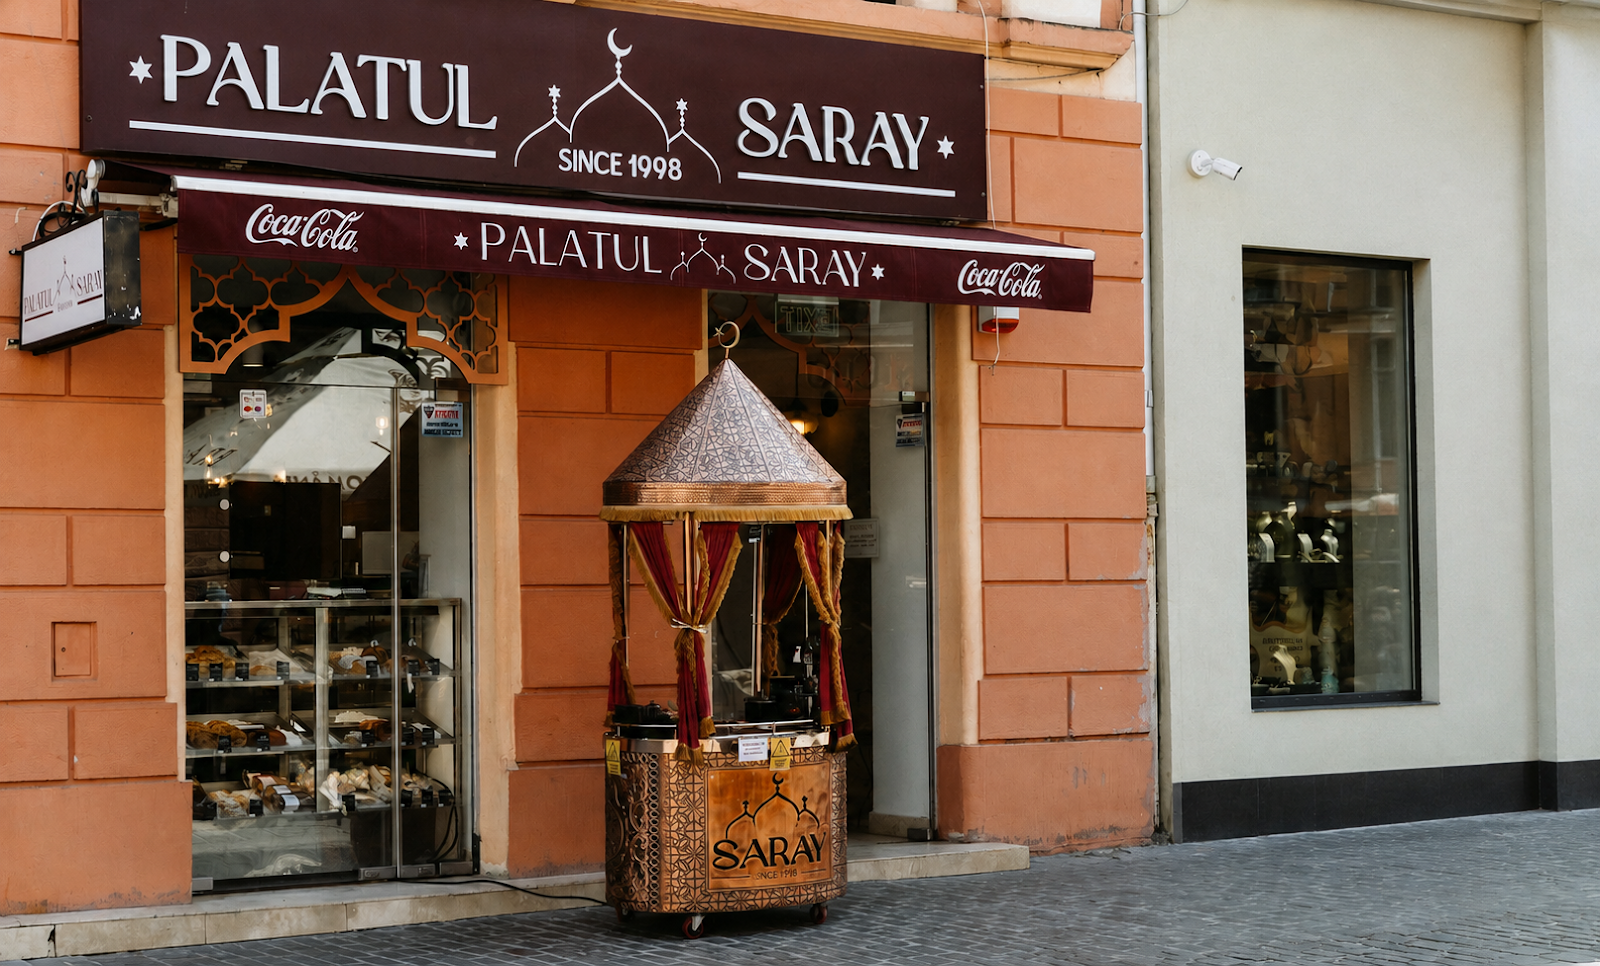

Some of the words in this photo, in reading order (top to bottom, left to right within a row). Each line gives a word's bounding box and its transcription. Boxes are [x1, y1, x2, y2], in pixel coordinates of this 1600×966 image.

[160, 34, 498, 130] PALATUL
[737, 97, 930, 171] SARAY
[558, 147, 623, 177] SINCE
[628, 153, 683, 182] 1998
[245, 203, 365, 251] Coca-Cola
[480, 221, 663, 274] PALATUL
[743, 243, 868, 288] SARAY
[77, 269, 103, 297] SARAY
[957, 259, 1046, 298] Coca-Cola
[712, 831, 827, 871] SARAY
[754, 870, 778, 880] SNCE
